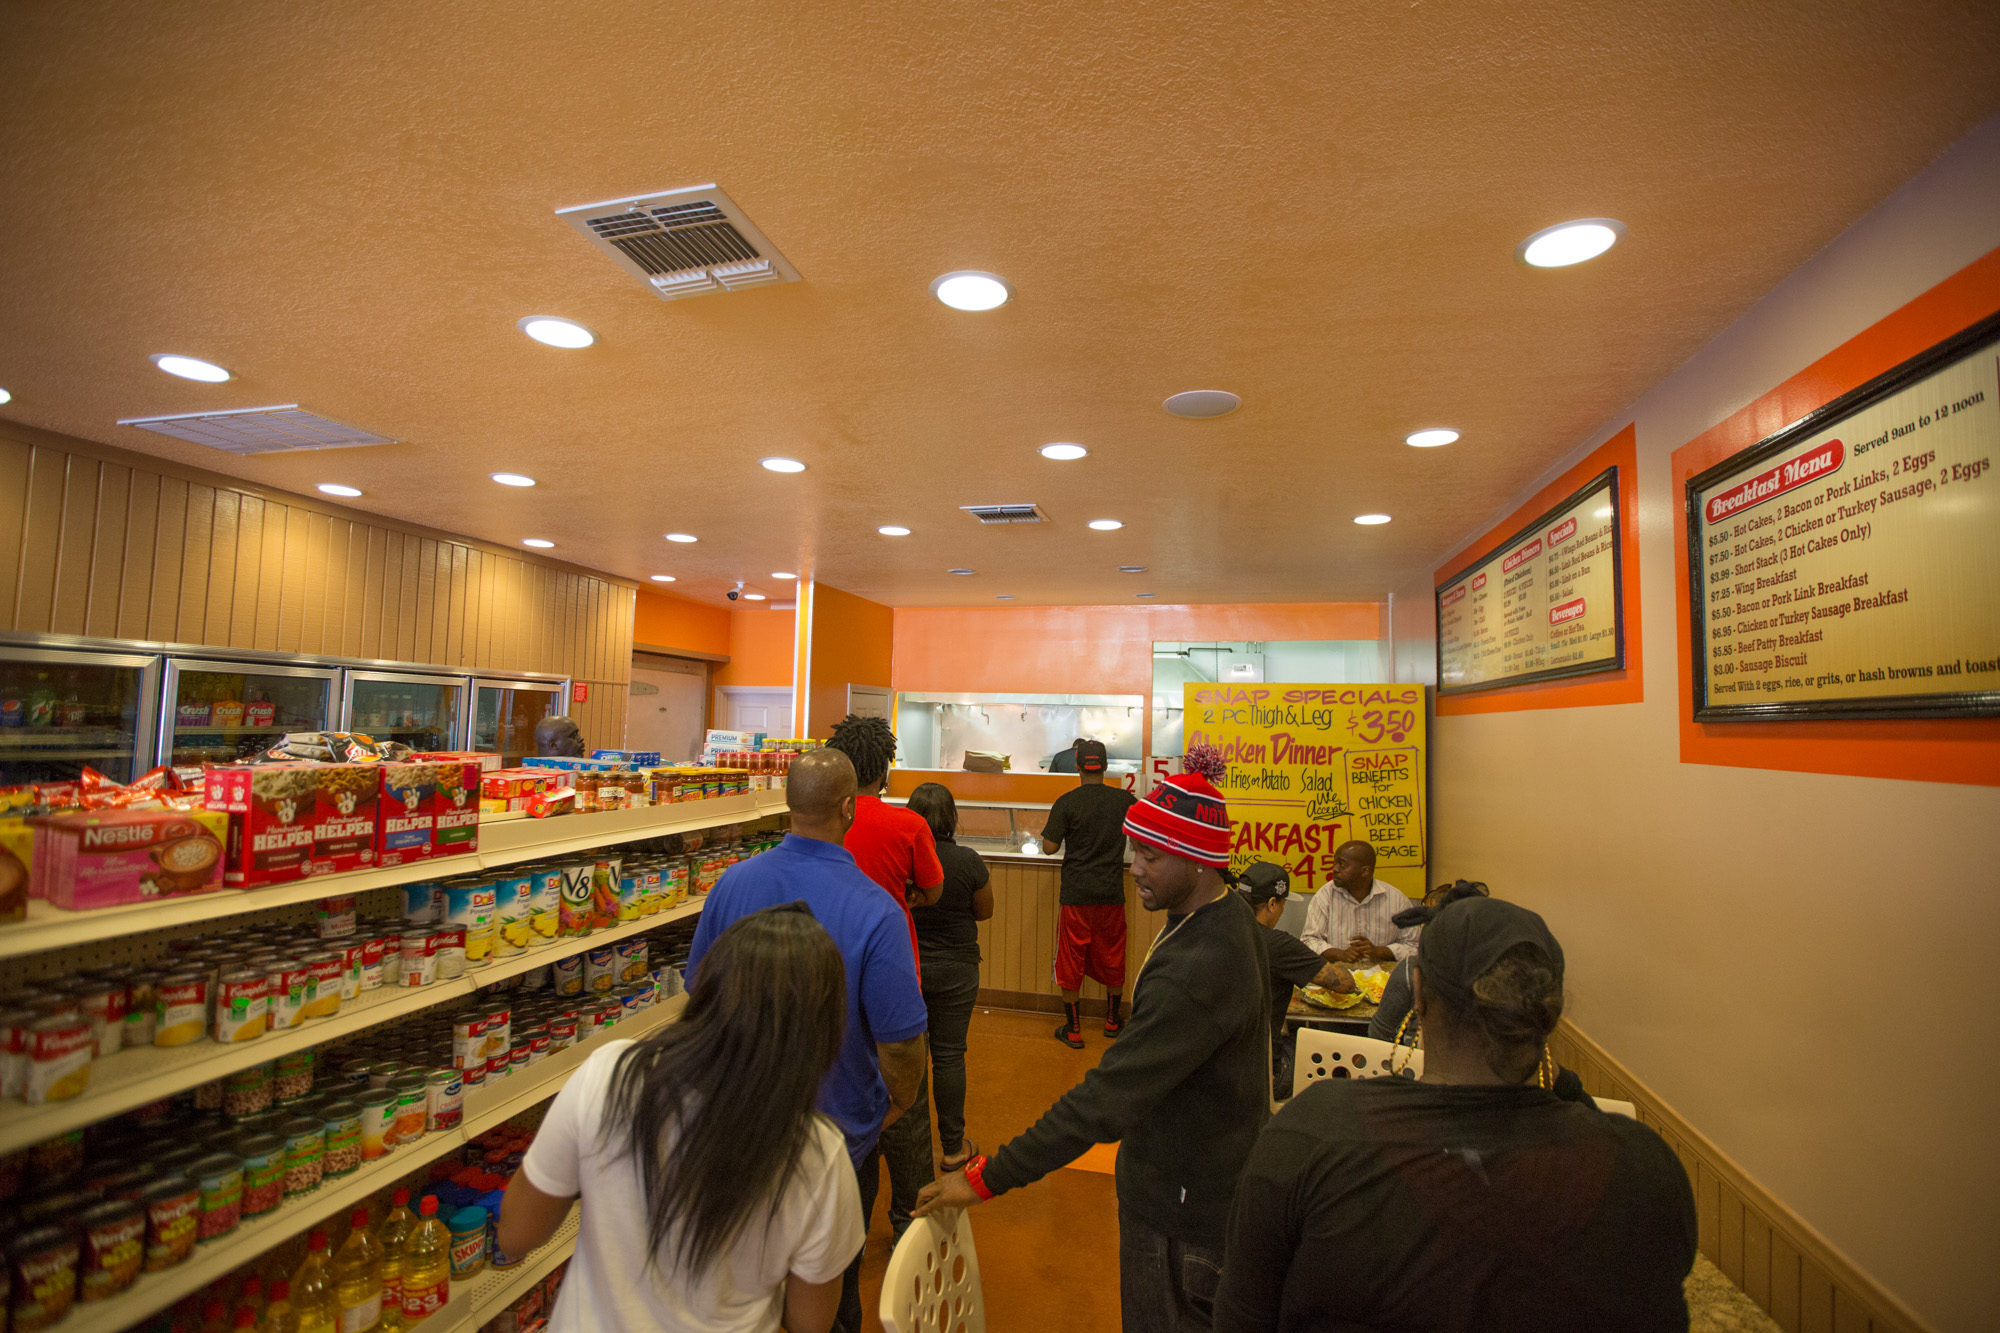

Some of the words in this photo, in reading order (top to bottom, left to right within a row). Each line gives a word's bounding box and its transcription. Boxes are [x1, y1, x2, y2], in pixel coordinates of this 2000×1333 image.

[1853, 431, 1889, 457] Served
[1891, 422, 1916, 440] 9am
[1918, 415, 1931, 428] to
[1934, 405, 1949, 421] 12
[1951, 391, 1985, 414] noon
[1711, 470, 1781, 517] Breakfast
[1784, 451, 1833, 486] Menu
[1709, 531, 1729, 548] $5.50
[1733, 523, 1747, 539] Hot
[1748, 514, 1776, 532] Cakes,
[1777, 508, 1783, 520] 2
[1783, 498, 1812, 519] Bacon
[1814, 494, 1825, 507] or
[1826, 481, 1851, 501] Pork
[1853, 469, 1889, 492] Links,
[1892, 461, 1900, 476] 2
[1902, 450, 1936, 473] Eggs
[1709, 549, 1729, 566] $7.50
[1734, 541, 1748, 557] Hot
[1748, 535, 1777, 552] Cakes,
[1777, 529, 1783, 542] 2
[1784, 518, 1824, 539] Chicken
[1826, 513, 1836, 525] or
[1837, 498, 1877, 520] Turkey
[1879, 478, 1937, 507] Sausage,
[1940, 468, 1948, 485] 2
[1951, 457, 1990, 482] Eggs
[1549, 521, 1575, 545] Specials
[1710, 568, 1730, 585] $3.99
[1734, 561, 1755, 577] Short
[1756, 554, 1779, 570] Stack
[1779, 549, 1788, 565] (3
[1789, 543, 1806, 560] Hot
[1807, 533, 1838, 553] Cakes
[1840, 521, 1872, 543] Only)
[1711, 587, 1731, 603] $7.25
[1735, 582, 1755, 596] Wing
[1756, 568, 1797, 590] Breakfast
[1711, 606, 1732, 621] $5.50
[1736, 601, 1760, 615] Bacon
[1761, 599, 1770, 609] or
[1771, 591, 1792, 607] Pork
[1794, 585, 1816, 601] Link
[1817, 572, 1868, 596] Breakfast
[1551, 602, 1584, 622] Beverages
[1712, 625, 1732, 640] $6.95
[1737, 619, 1768, 634] Chicken
[1769, 617, 1778, 628] or
[1779, 610, 1809, 626] Turkey
[1811, 602, 1851, 620] Sausage
[1853, 587, 1908, 612] Breakfast
[1737, 641, 1756, 654] Beef
[1756, 637, 1777, 652] Patty
[1778, 629, 1823, 648] Breakfast
[1713, 663, 1735, 676] $3.00
[1739, 659, 1774, 674] Sausage
[1775, 652, 1808, 669] Biscuit
[1713, 682, 1737, 694] Served
[1737, 680, 1754, 692] With
[1756, 680, 1760, 690] 2
[1762, 680, 1784, 693] eggs,
[1784, 676, 1804, 689] rice,
[1805, 677, 1815, 687] or
[1816, 672, 1843, 689] grits,
[1845, 673, 1856, 684] or
[1858, 667, 1885, 682] hash
[1887, 666, 1933, 680] browns
[1936, 659, 1962, 676] and
[1194, 687, 1271, 706] SNAP
[1282, 689, 1419, 708] SPECIALS
[181, 705, 209, 715] Crush
[216, 706, 242, 715] Crush
[249, 706, 273, 715] Crush
[1203, 709, 1216, 724] 2
[1285, 705, 1300, 728] &
[1301, 705, 1333, 731] Leg
[711, 733, 738, 741] PREMIUM
[1270, 732, 1343, 765] Dinner
[1153, 760, 1170, 785] 5
[1351, 753, 1408, 771] SNAP
[1125, 773, 1136, 793] 2
[1231, 766, 1251, 790] Fries
[1261, 768, 1290, 791] Potato
[1300, 768, 1333, 793] Salad
[1351, 768, 1409, 784] BENEFITS
[1371, 781, 1394, 794] for
[1359, 793, 1413, 810] CHICKEN
[326, 815, 365, 825] Hamburger
[385, 816, 433, 833] HELPER
[437, 813, 478, 829] HELPER
[1360, 809, 1413, 827] TURKEY
[266, 824, 305, 835] Hamburger
[314, 821, 374, 840] HELPER
[1229, 820, 1342, 856] EAKFAST
[1369, 827, 1405, 842] BEEF
[253, 830, 313, 851] HELPER
[564, 868, 590, 899] V8
